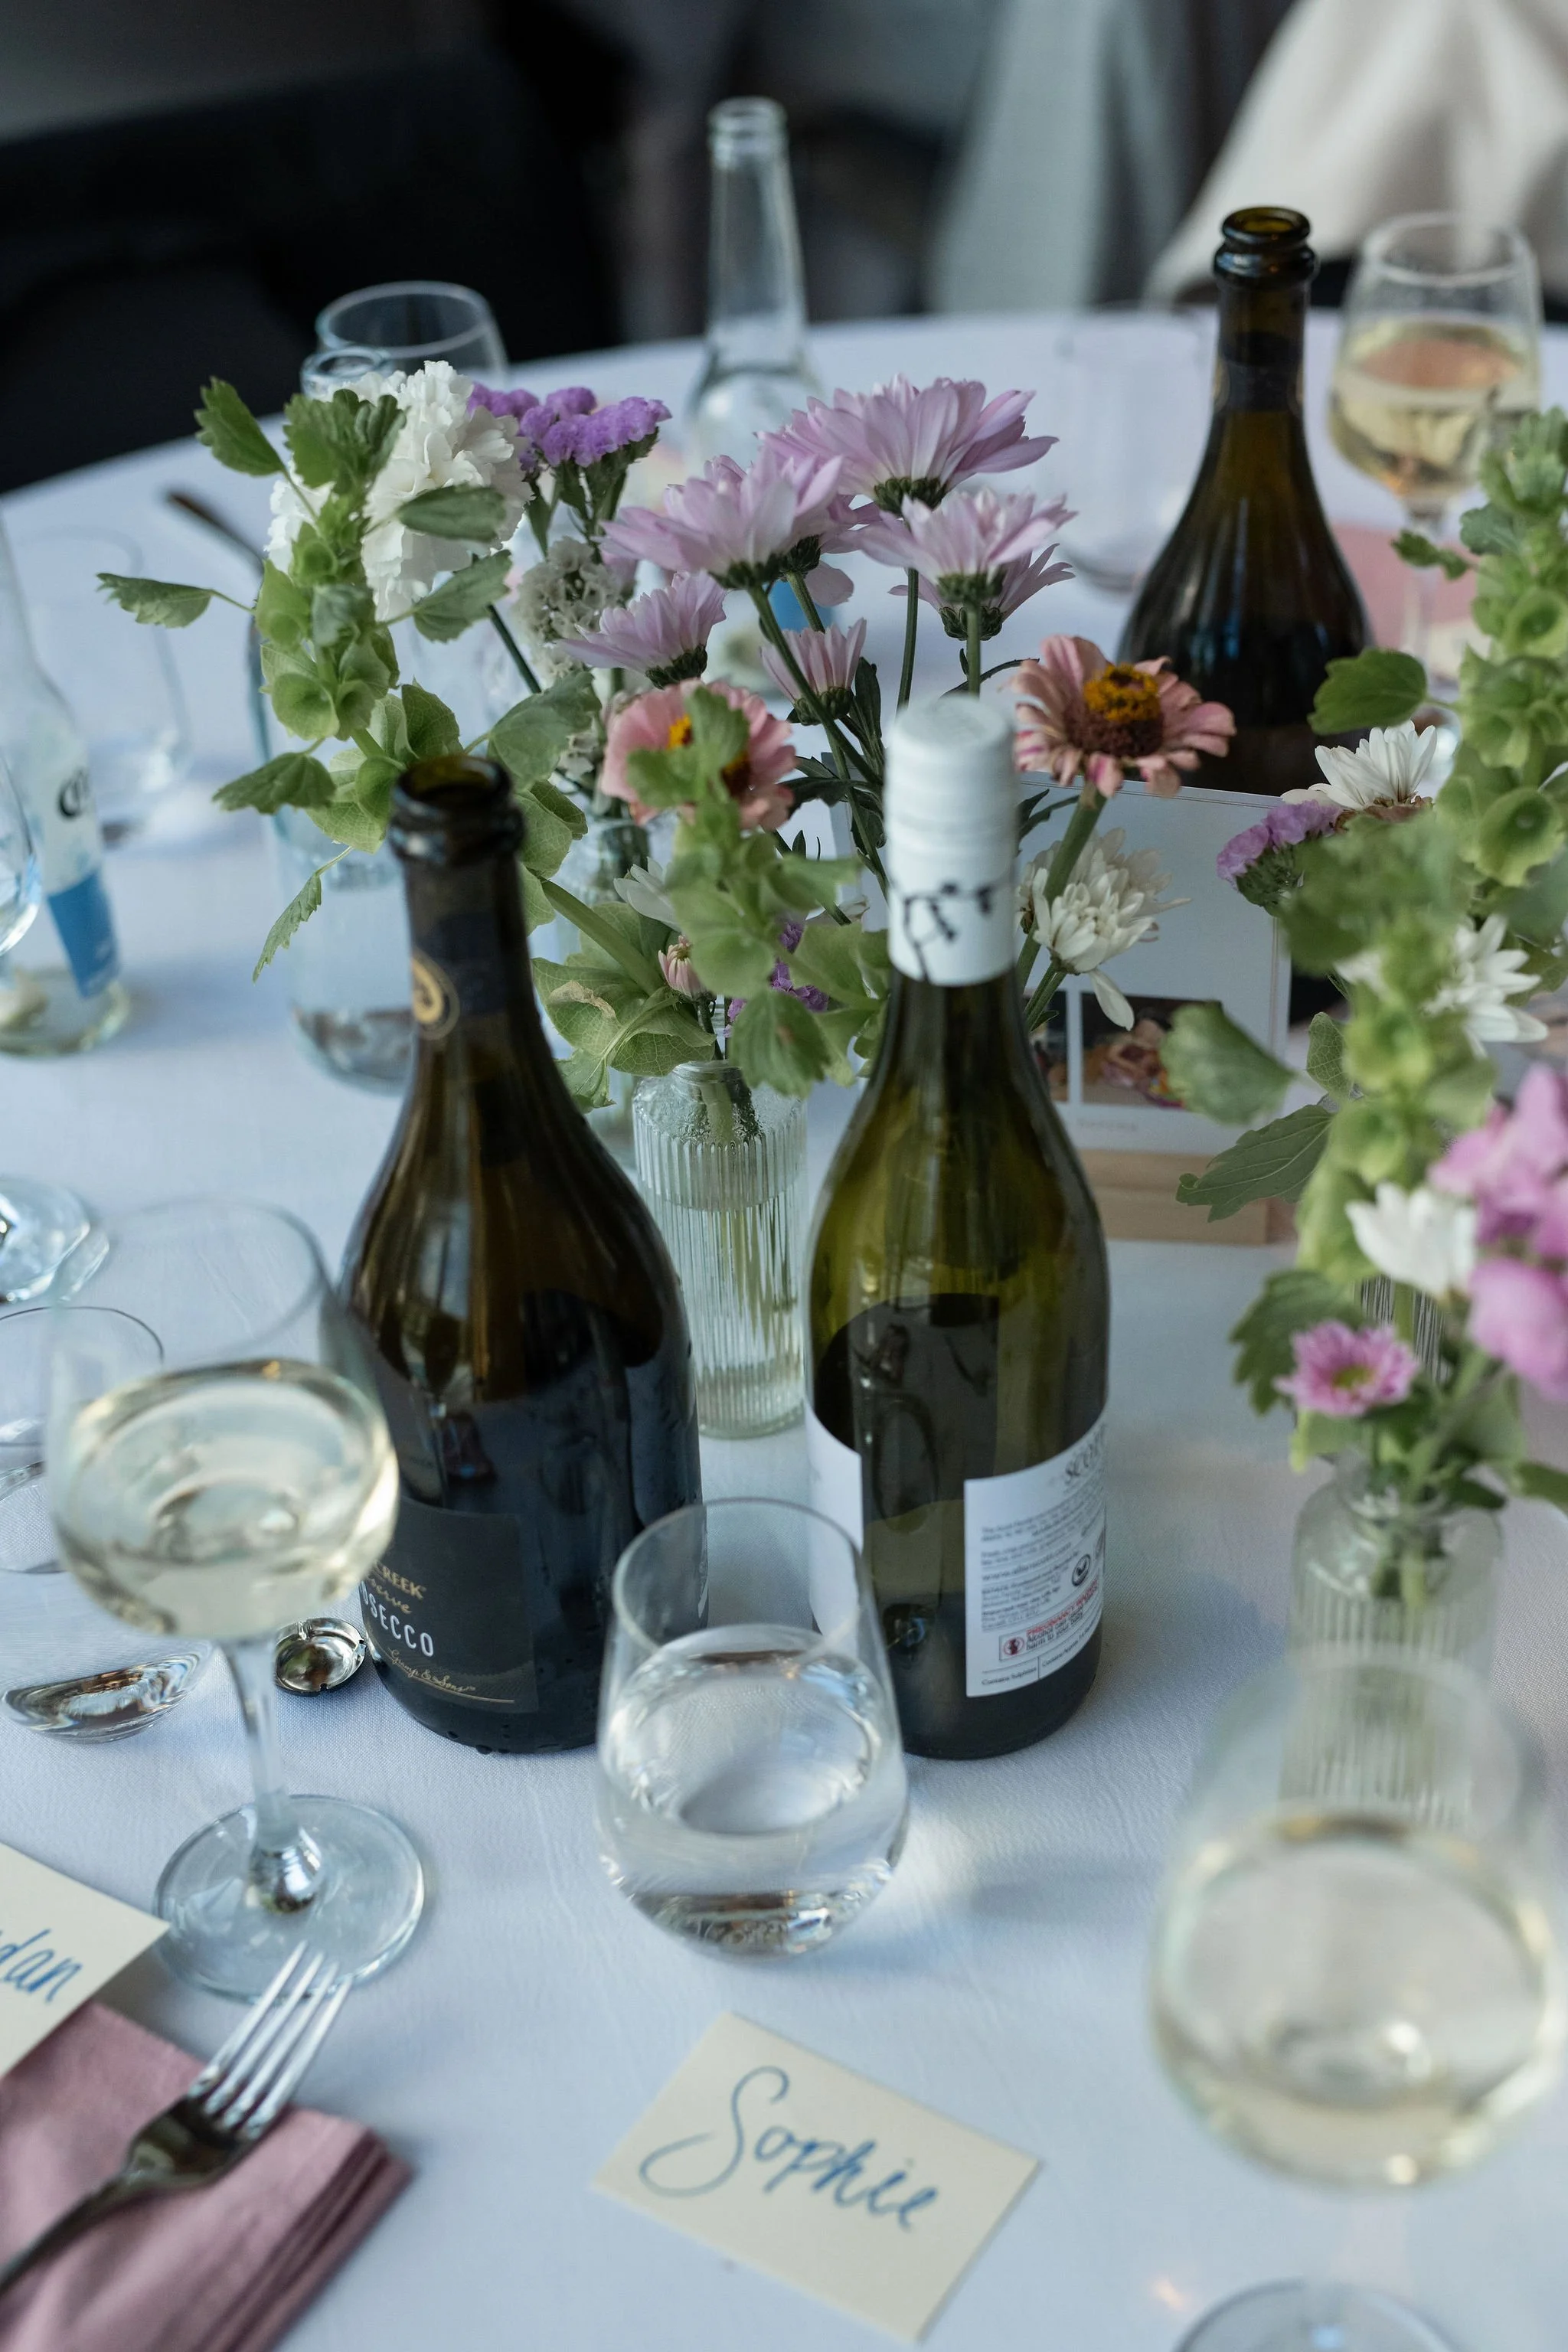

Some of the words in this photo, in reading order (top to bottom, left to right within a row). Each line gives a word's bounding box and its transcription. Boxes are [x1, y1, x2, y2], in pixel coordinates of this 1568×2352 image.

[359, 1579, 434, 1657] OSECCO
[367, 1576, 413, 1615] serve
[0, 1928, 83, 2004] dan
[639, 2065, 939, 2232] Sophie
